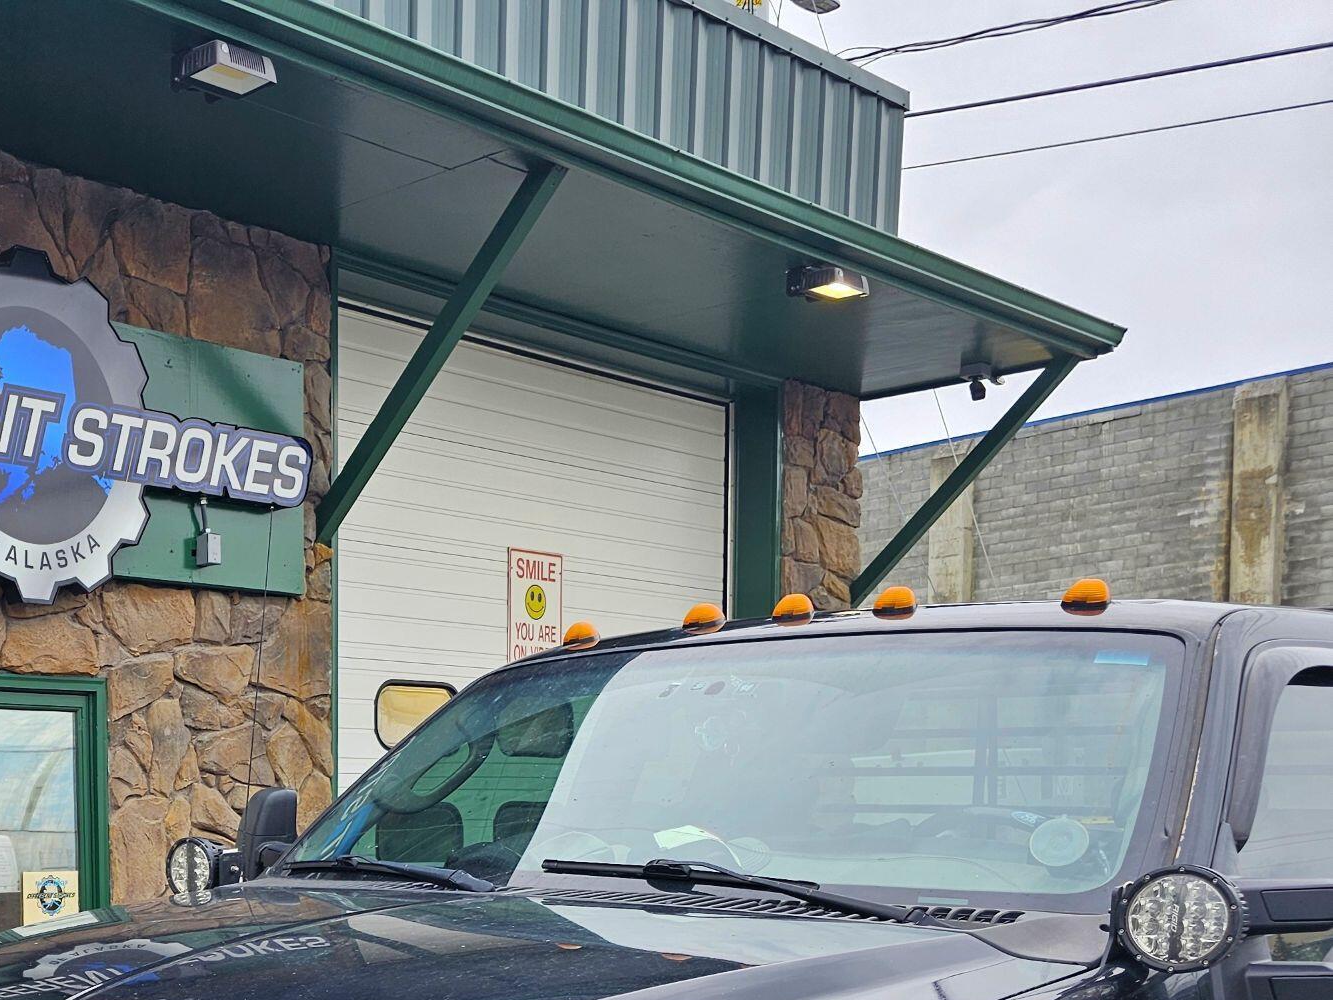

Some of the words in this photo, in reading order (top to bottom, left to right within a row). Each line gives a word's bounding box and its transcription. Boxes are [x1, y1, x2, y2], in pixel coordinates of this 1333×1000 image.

[68, 407, 307, 500] STROKES
[4, 533, 101, 571] ALASKA
[516, 557, 556, 582] SMILE
[515, 622, 534, 642] YOU
[538, 625, 557, 643] ARE
[513, 645, 527, 660] ON
[1170, 903, 1180, 933] RIGID
